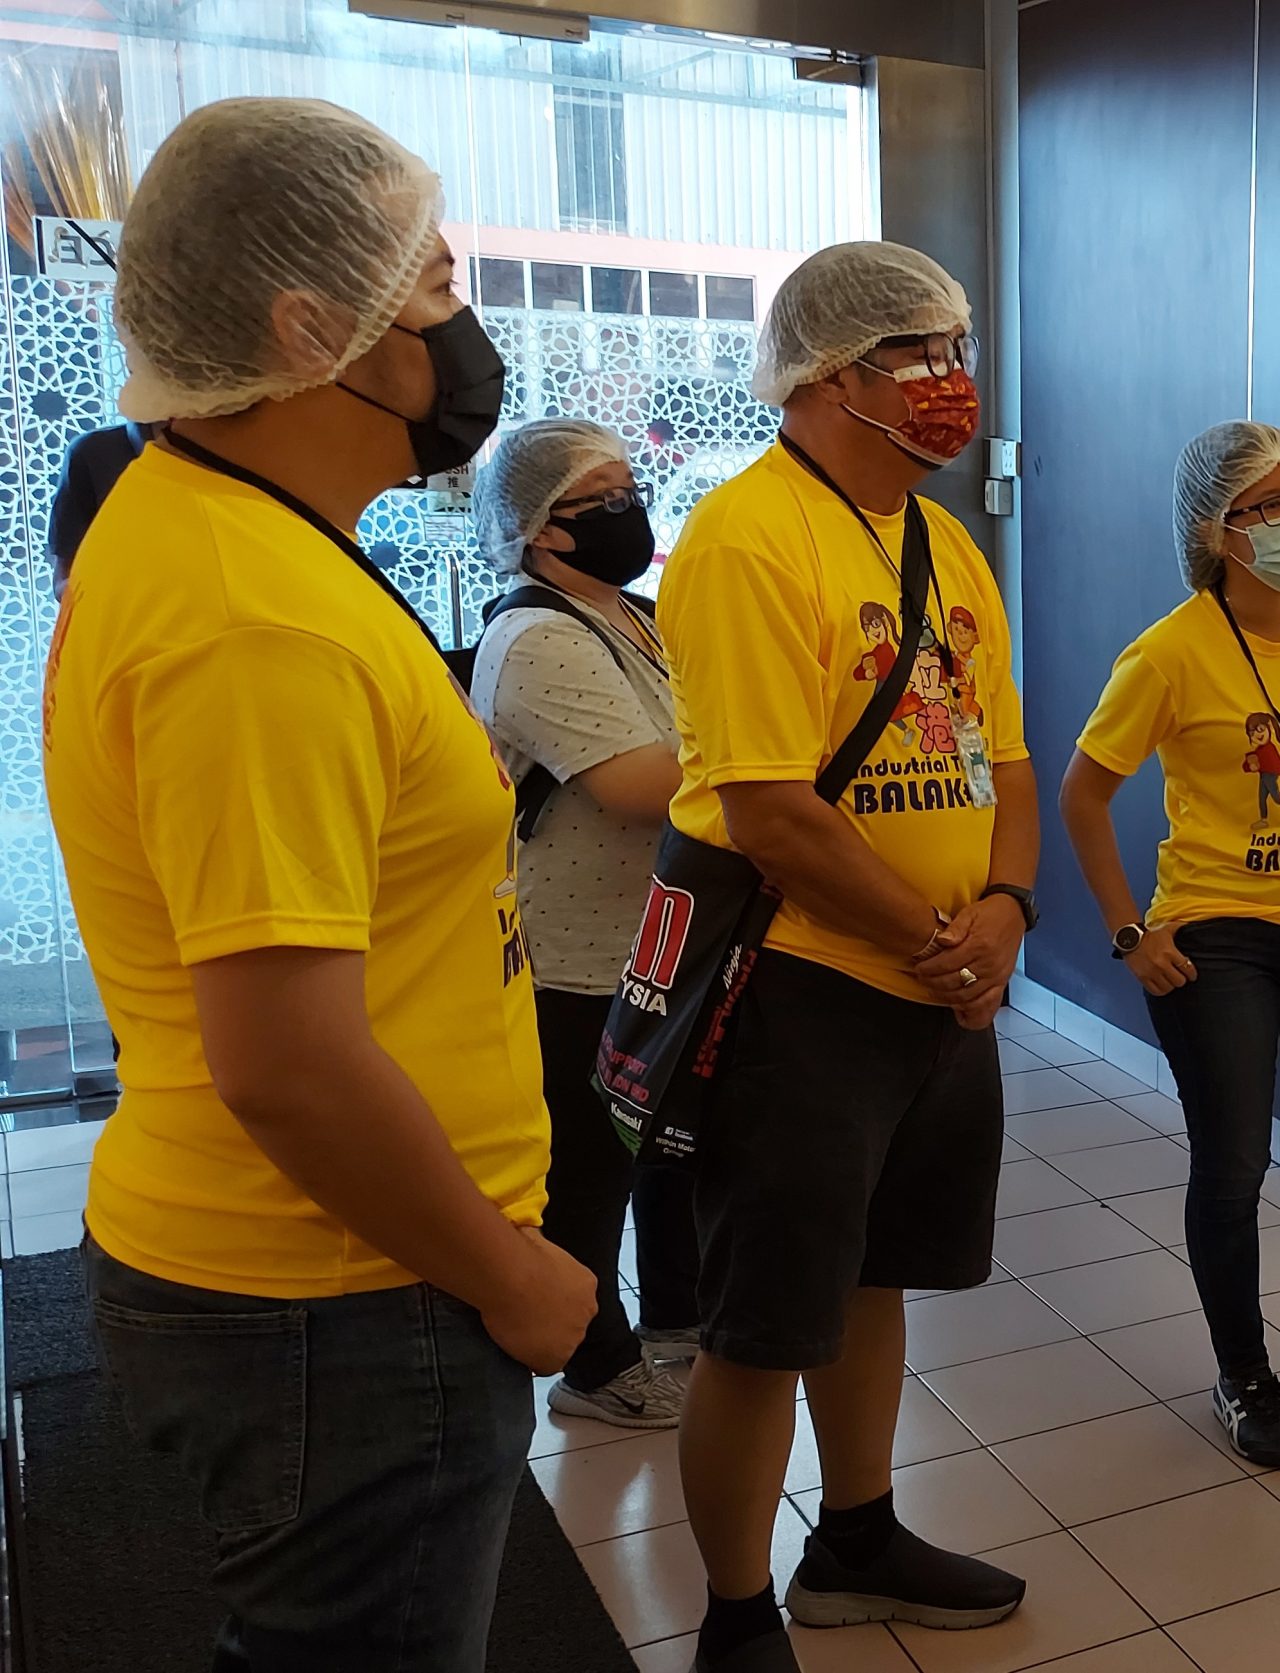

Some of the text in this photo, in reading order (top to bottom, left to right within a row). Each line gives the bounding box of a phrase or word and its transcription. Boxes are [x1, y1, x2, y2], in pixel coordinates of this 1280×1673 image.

[445, 464, 469, 475] SH
[447, 475, 459, 488] 推
[854, 778, 973, 815] BALAK
[722, 944, 743, 990] Ninja
[611, 1101, 642, 1133] Kawasaki
